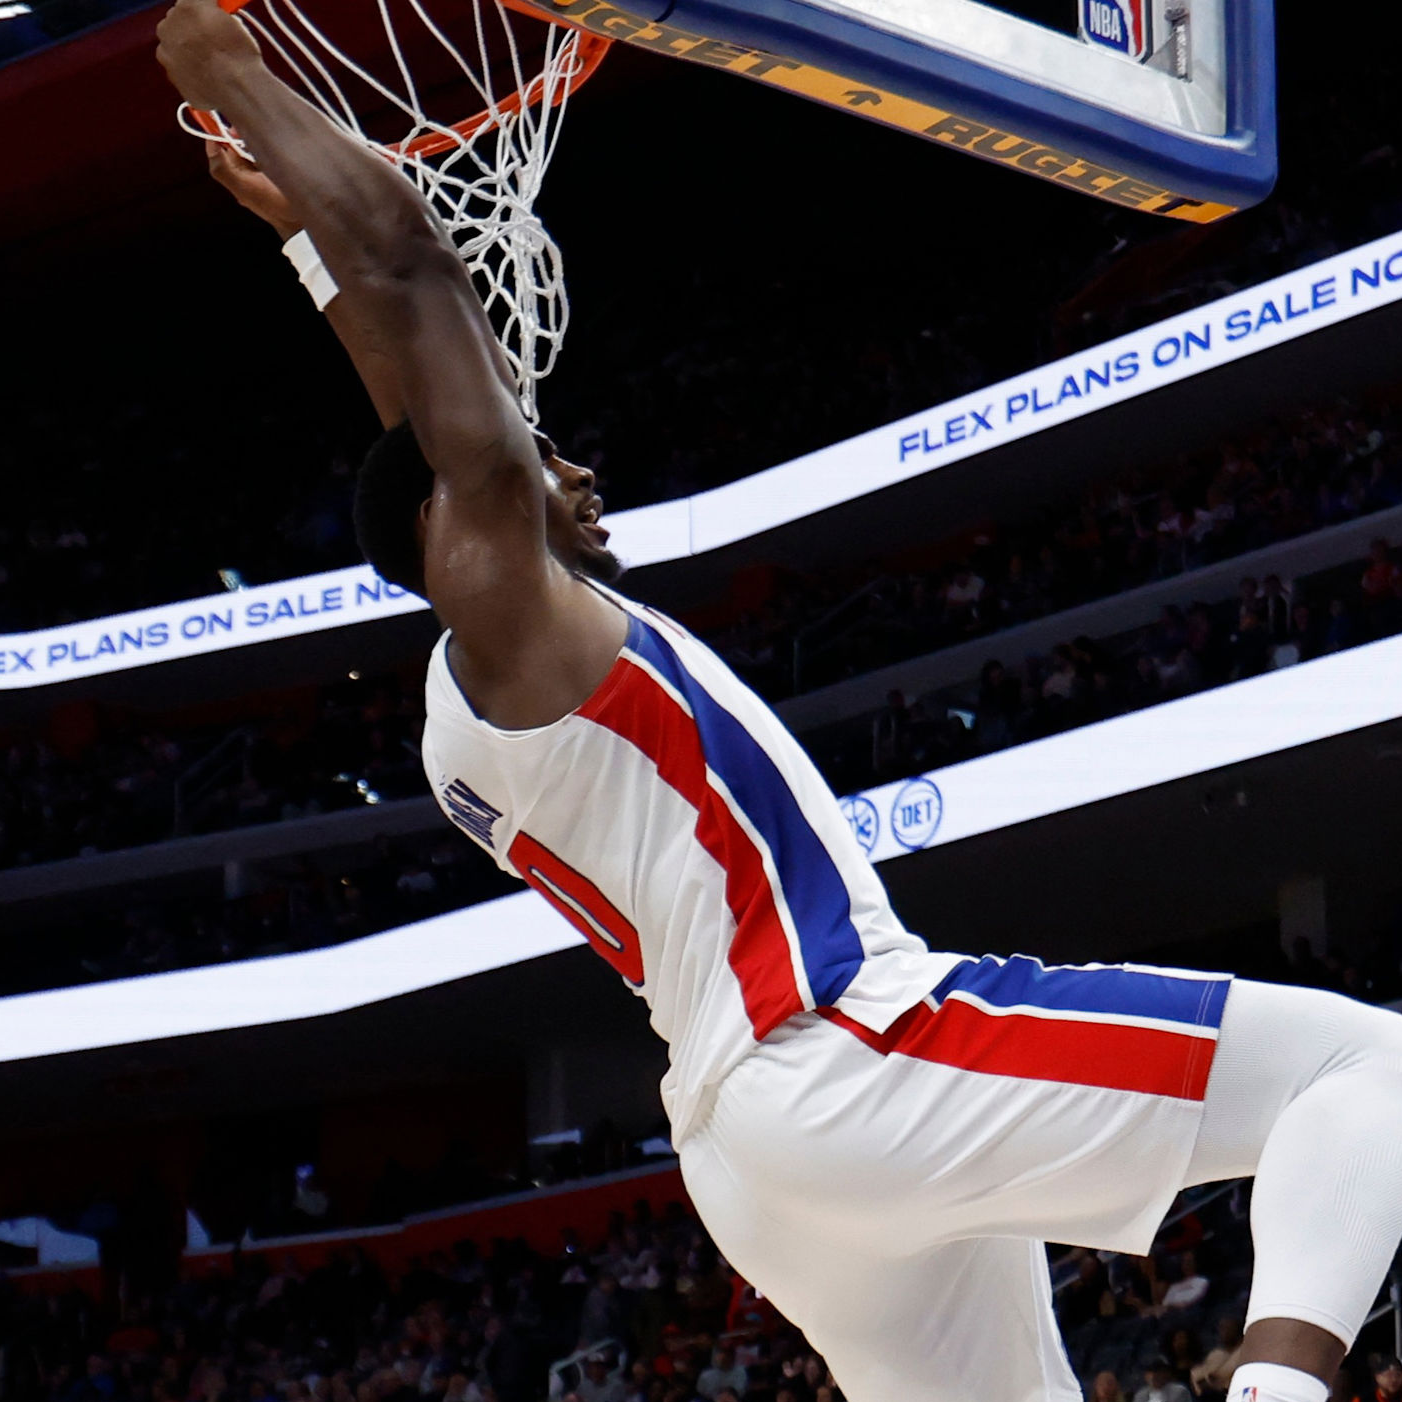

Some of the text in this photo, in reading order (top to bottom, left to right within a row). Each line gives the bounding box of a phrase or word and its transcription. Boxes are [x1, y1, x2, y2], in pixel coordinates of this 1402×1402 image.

[1089, 0, 1122, 43] NBA
[898, 404, 994, 463] FLEX
[1005, 352, 1141, 425] PLANS
[1151, 324, 1212, 369] ON
[1224, 276, 1337, 343] SALE
[47, 622, 170, 667] PLANS
[180, 608, 235, 641] ON
[244, 586, 343, 627] SALE
[901, 800, 931, 828] DET
